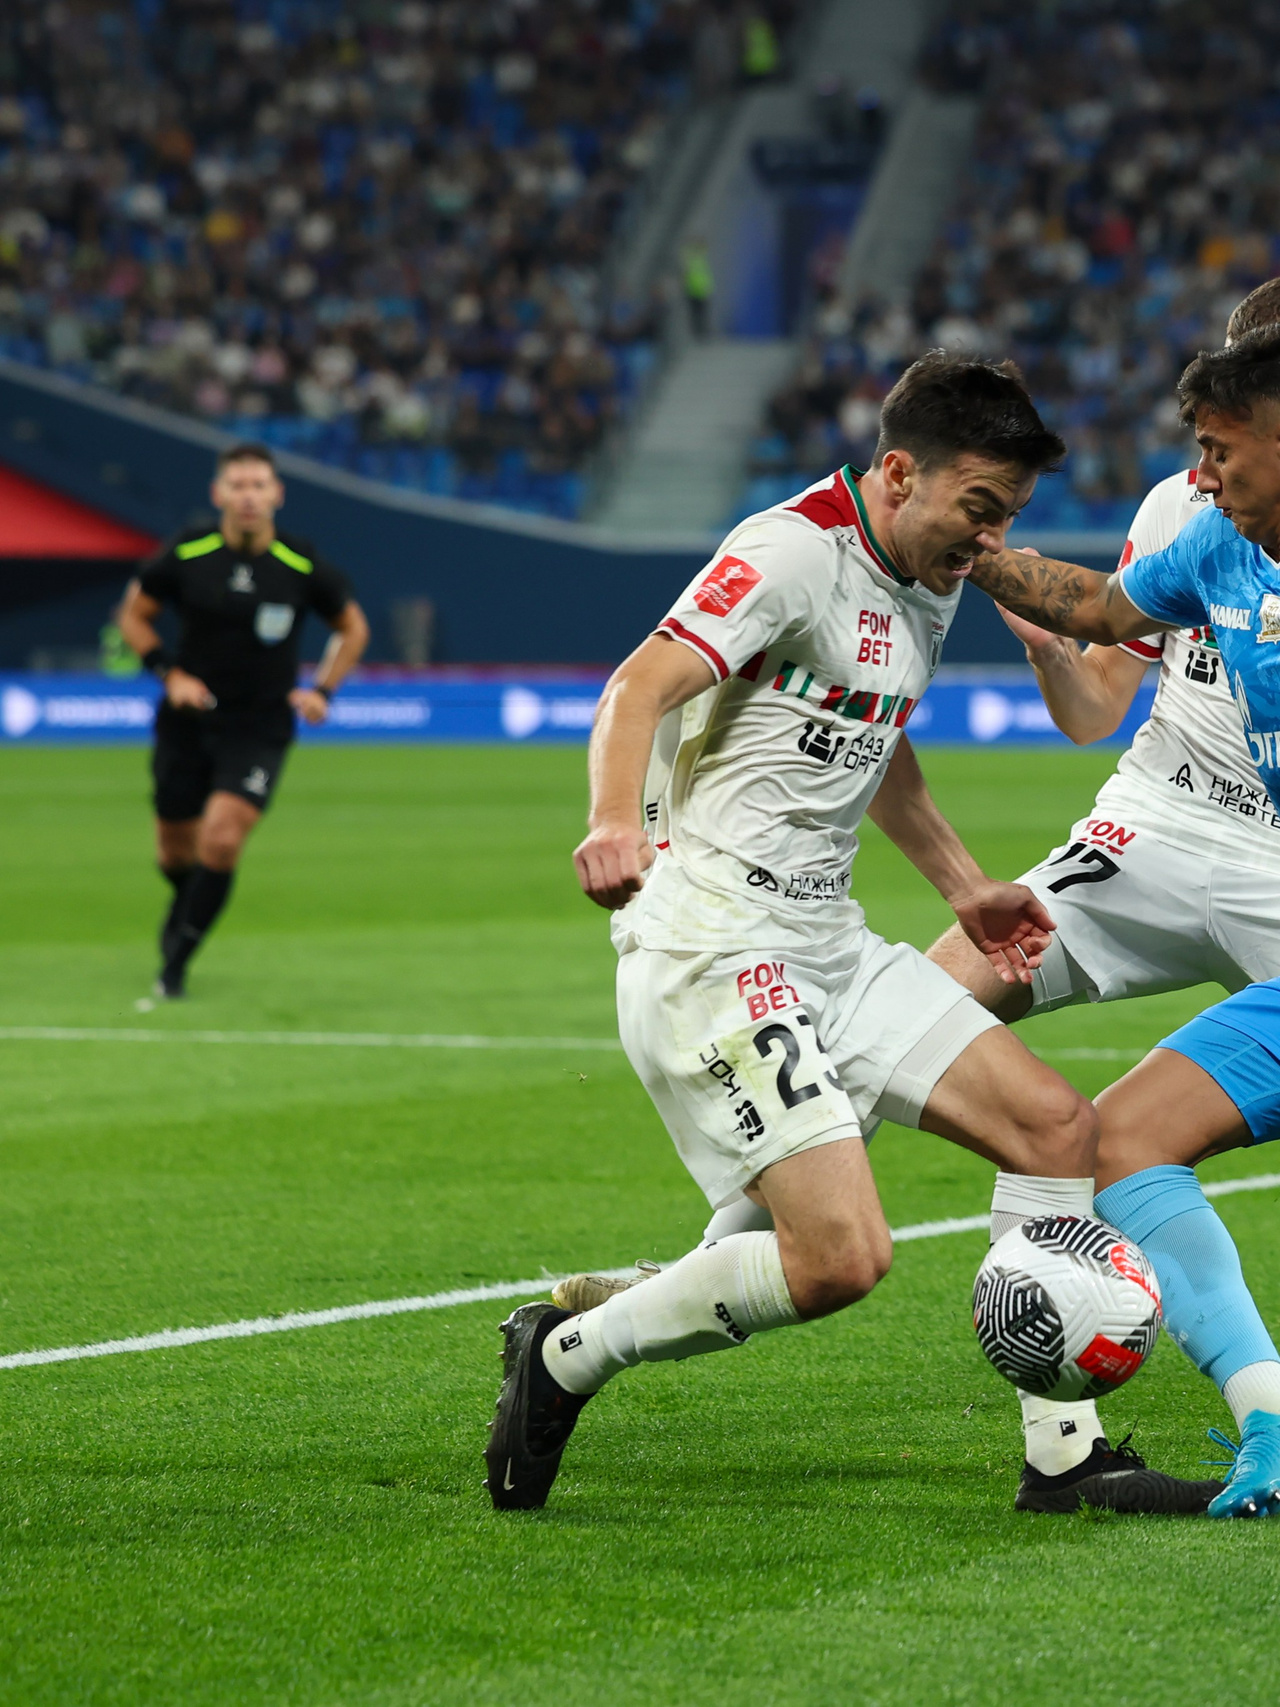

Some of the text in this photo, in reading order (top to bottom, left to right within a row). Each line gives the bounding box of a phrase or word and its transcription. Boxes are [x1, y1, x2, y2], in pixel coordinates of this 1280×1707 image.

[858, 610, 892, 638] FON
[1210, 603, 1251, 631] KAMAZ
[856, 637, 893, 667] BET
[747, 984, 800, 1022] BET
